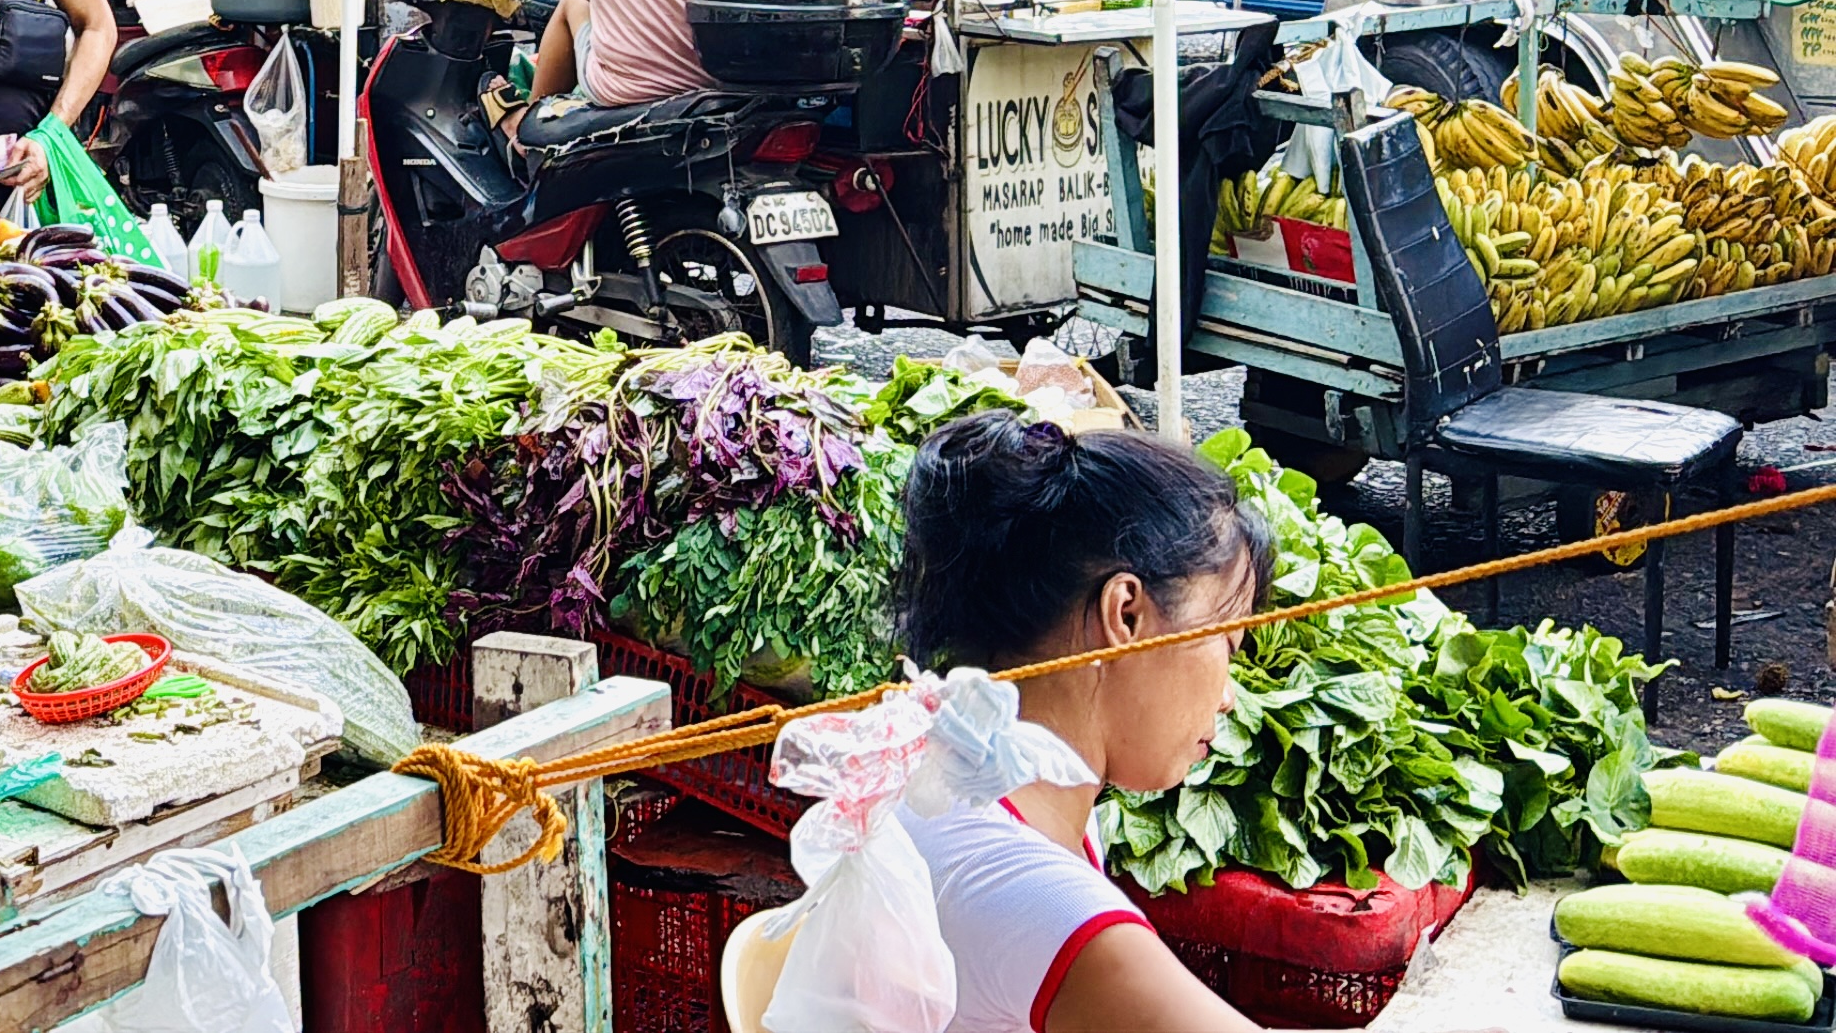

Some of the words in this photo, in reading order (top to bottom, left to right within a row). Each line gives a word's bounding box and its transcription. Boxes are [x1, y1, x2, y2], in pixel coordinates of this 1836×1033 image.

[976, 94, 1050, 171] LUCKY
[982, 177, 1044, 212] MASARAP
[1059, 170, 1110, 203] BALIK-B
[1039, 211, 1074, 244] made
